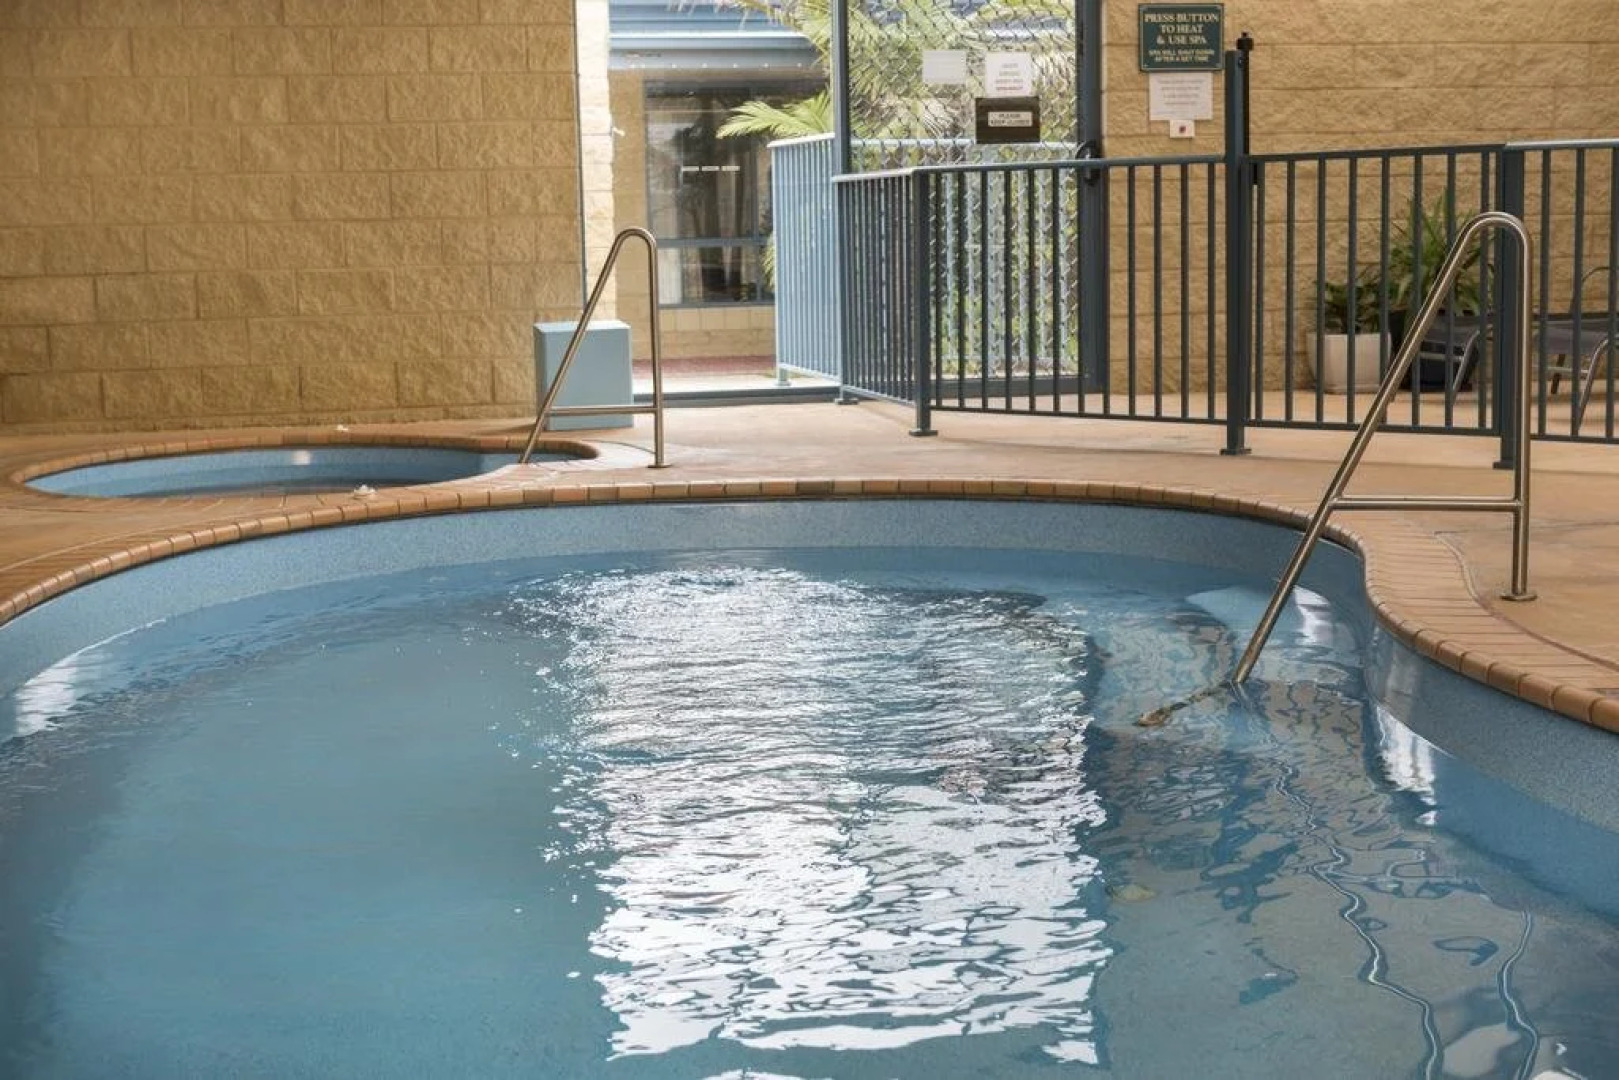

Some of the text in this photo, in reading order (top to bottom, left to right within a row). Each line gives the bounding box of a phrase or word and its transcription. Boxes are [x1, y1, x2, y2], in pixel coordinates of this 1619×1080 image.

[1144, 13, 1219, 23] PRESS BUTTON
[1161, 24, 1204, 34] TO HEAT
[1188, 35, 1207, 44] SPA
